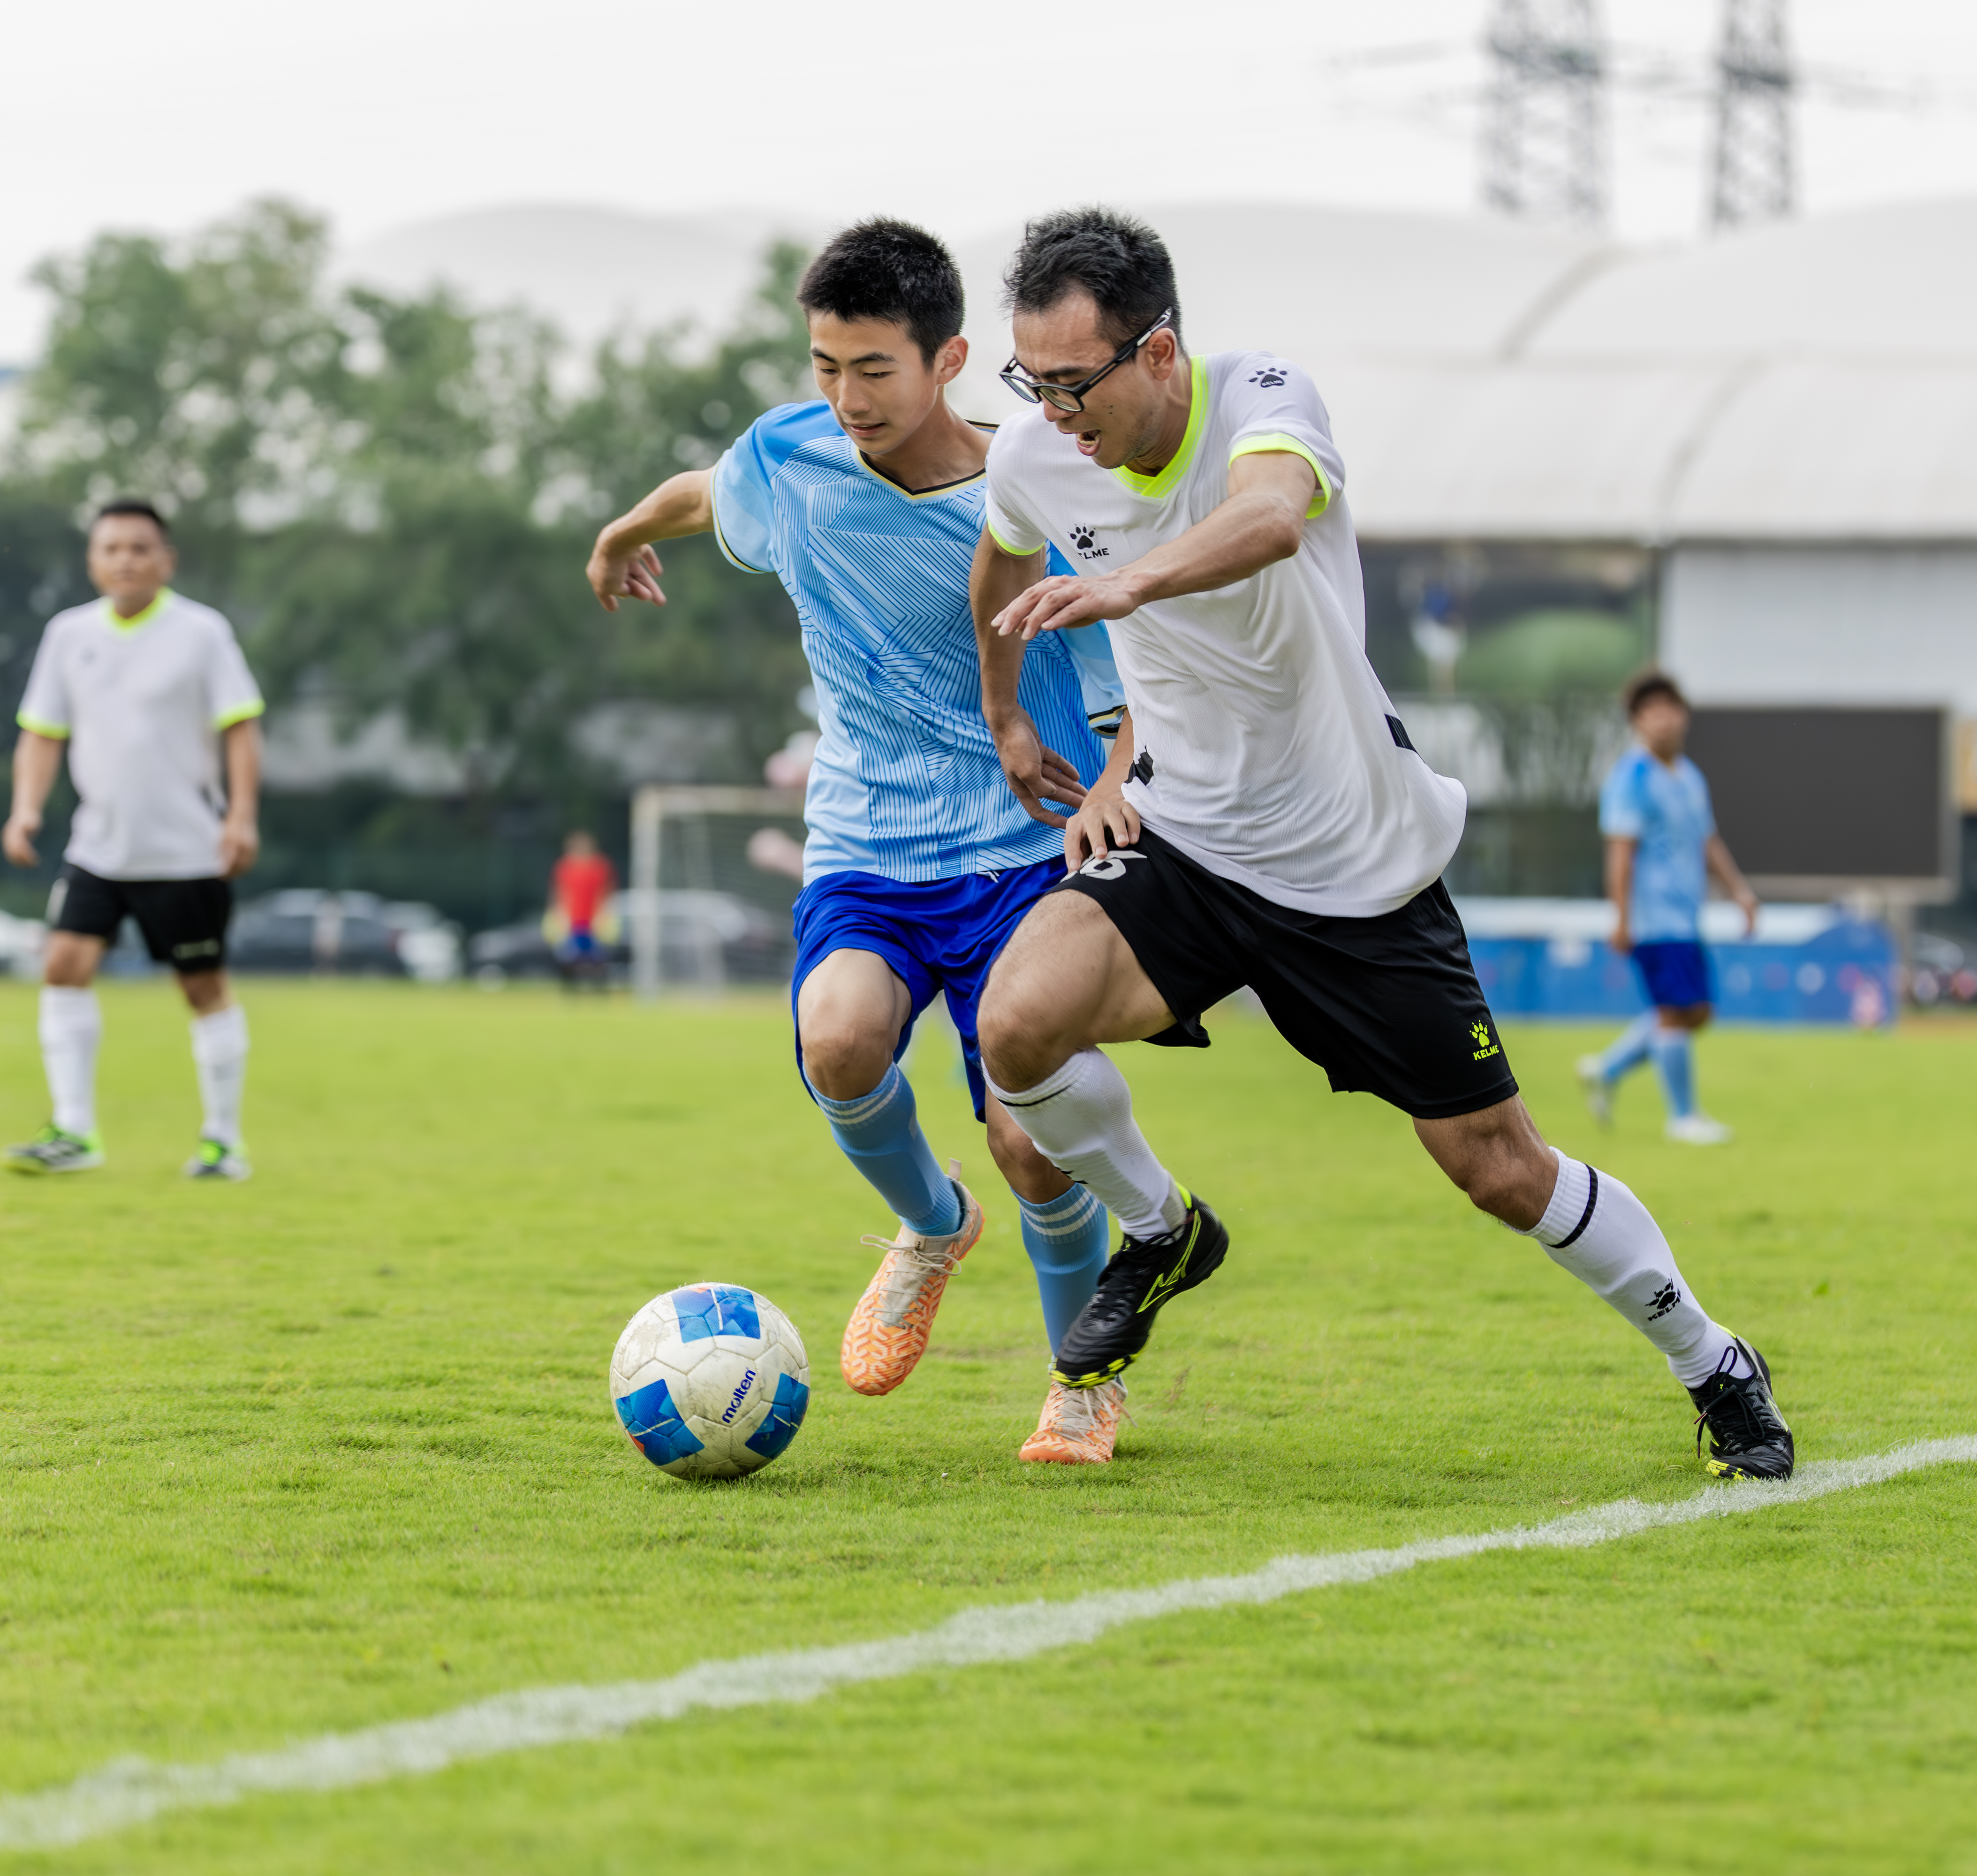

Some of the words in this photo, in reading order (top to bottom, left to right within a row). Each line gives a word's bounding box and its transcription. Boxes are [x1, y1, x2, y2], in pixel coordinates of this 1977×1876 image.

[1077, 548, 1110, 560] LME
[1473, 1044, 1500, 1061] KELME
[721, 1369, 757, 1424] molten
